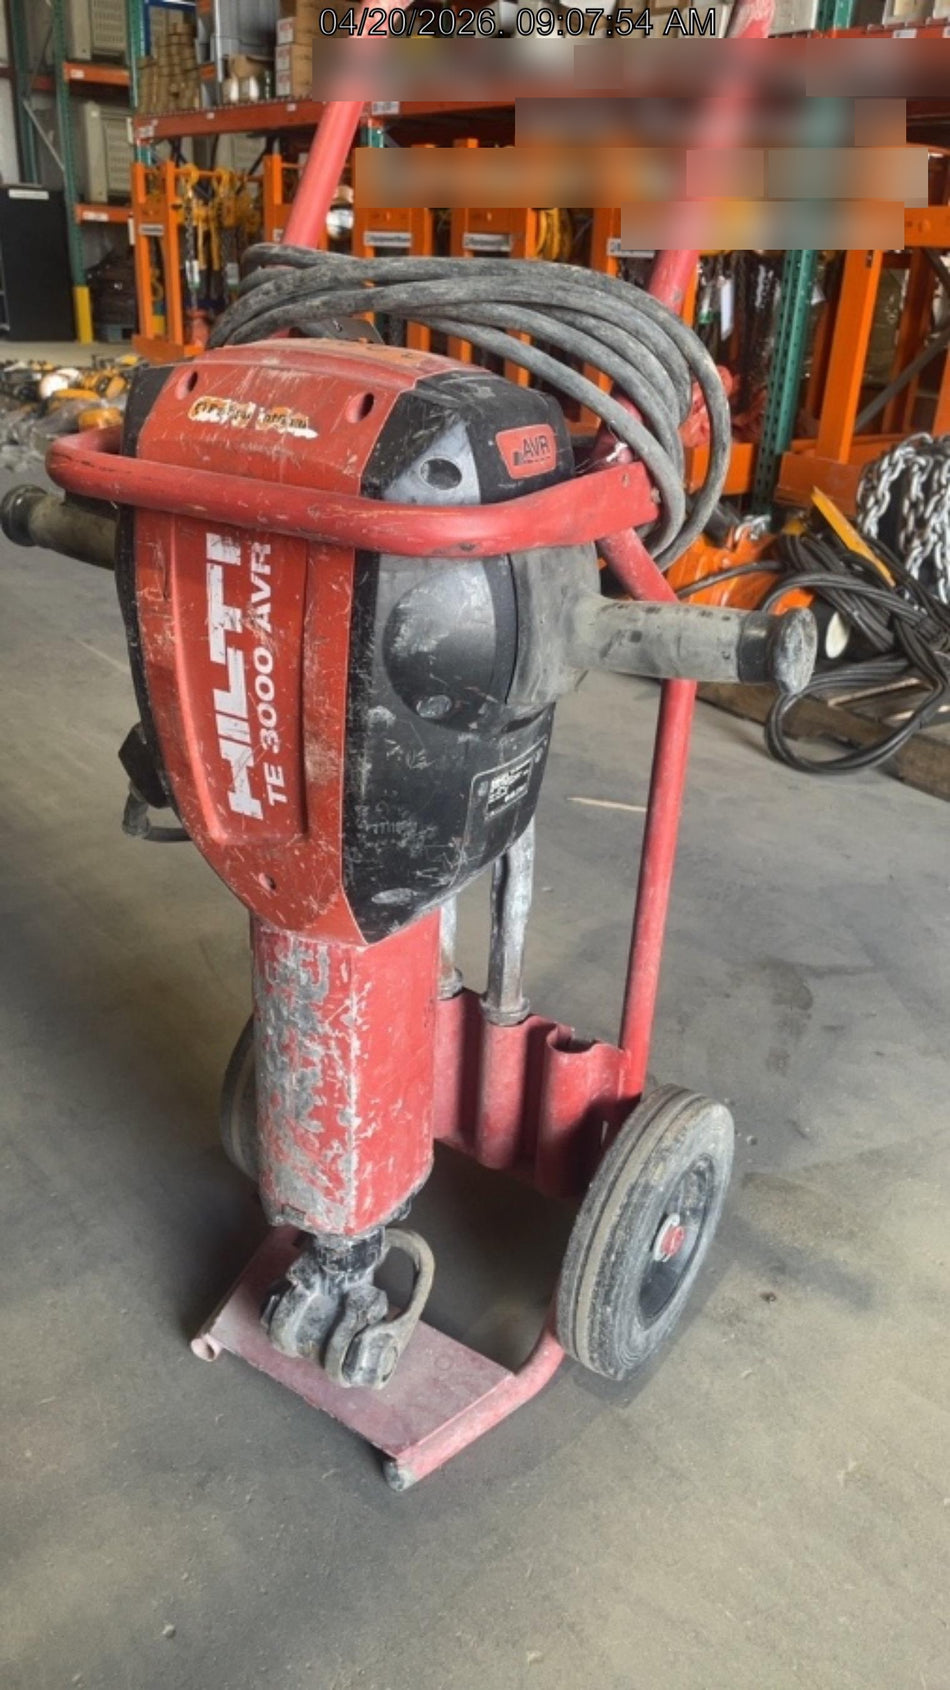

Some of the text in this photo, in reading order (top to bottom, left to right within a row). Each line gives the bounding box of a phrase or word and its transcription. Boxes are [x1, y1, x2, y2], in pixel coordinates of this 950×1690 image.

[523, 435, 550, 458] AVR
[206, 532, 264, 820] HILTI
[250, 542, 288, 806] TE 3000 AVR
